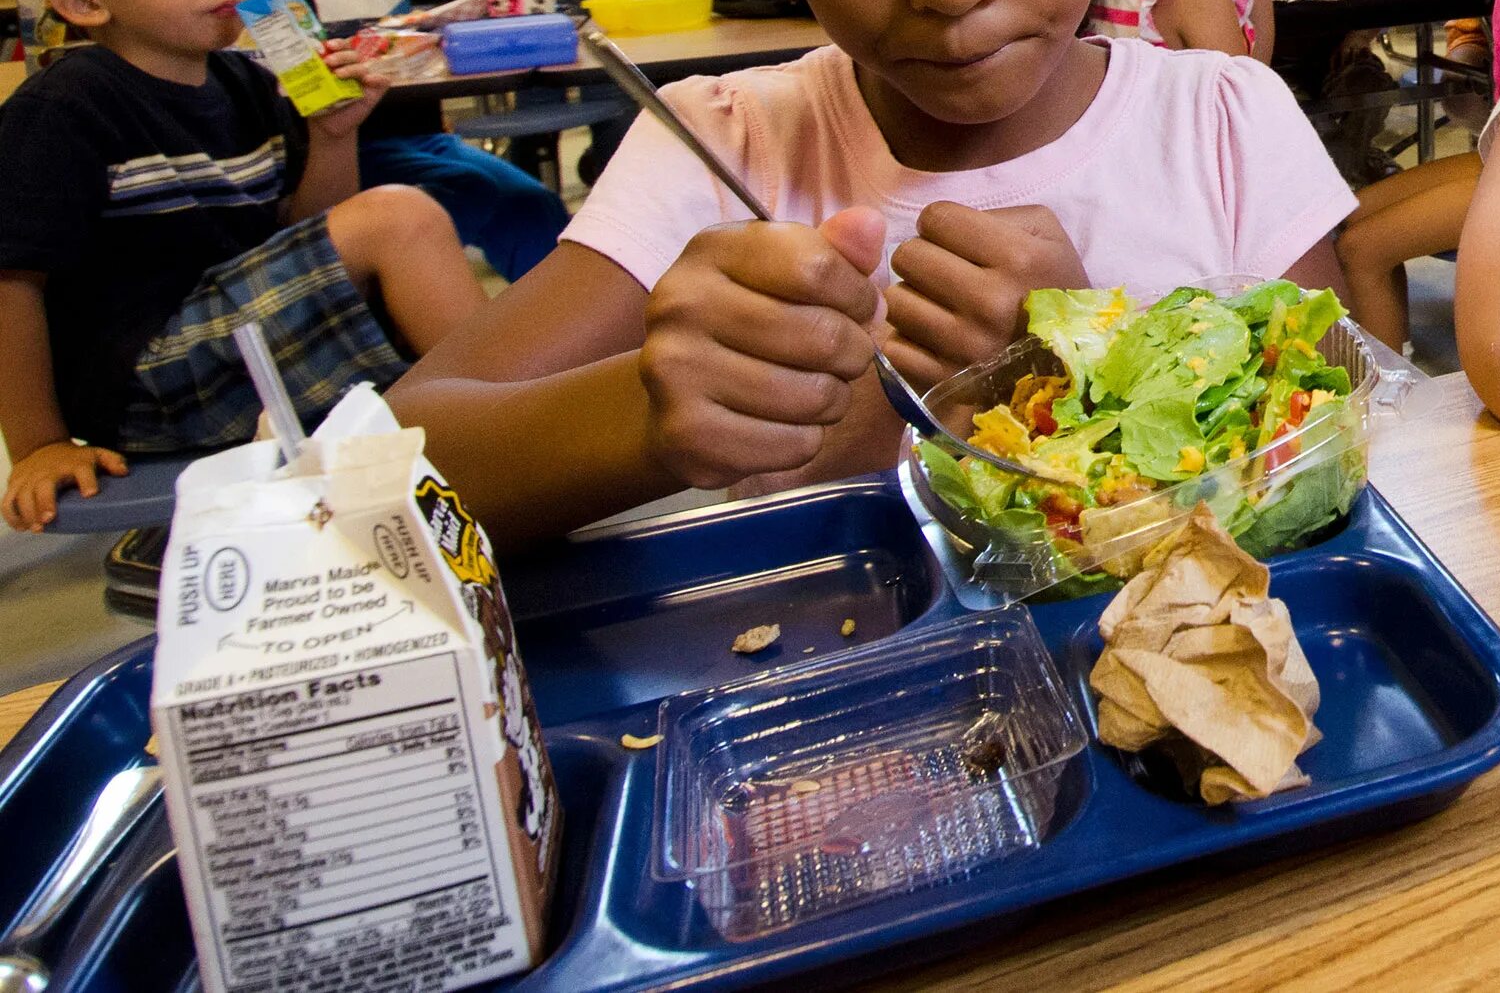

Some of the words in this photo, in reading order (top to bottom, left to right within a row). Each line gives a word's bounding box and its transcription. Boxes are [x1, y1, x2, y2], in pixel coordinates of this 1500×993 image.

[179, 544, 200, 571] UP
[391, 513, 420, 565] PUSH
[413, 562, 433, 584] UP
[218, 559, 237, 602] HERE
[262, 591, 321, 612] Proud
[327, 586, 345, 601] to
[352, 580, 375, 596] be
[263, 573, 321, 594] Marva
[177, 577, 199, 627] PUSH
[246, 609, 315, 633] Farmer
[321, 594, 388, 619] Owned
[263, 640, 294, 654] TO
[302, 622, 372, 651] OPEN
[175, 676, 222, 697] GRADE
[250, 656, 339, 682] PASTEURIZED
[354, 632, 449, 663] HOMOGENIZED
[180, 688, 298, 722] Nutrition
[307, 671, 383, 698] Facts
